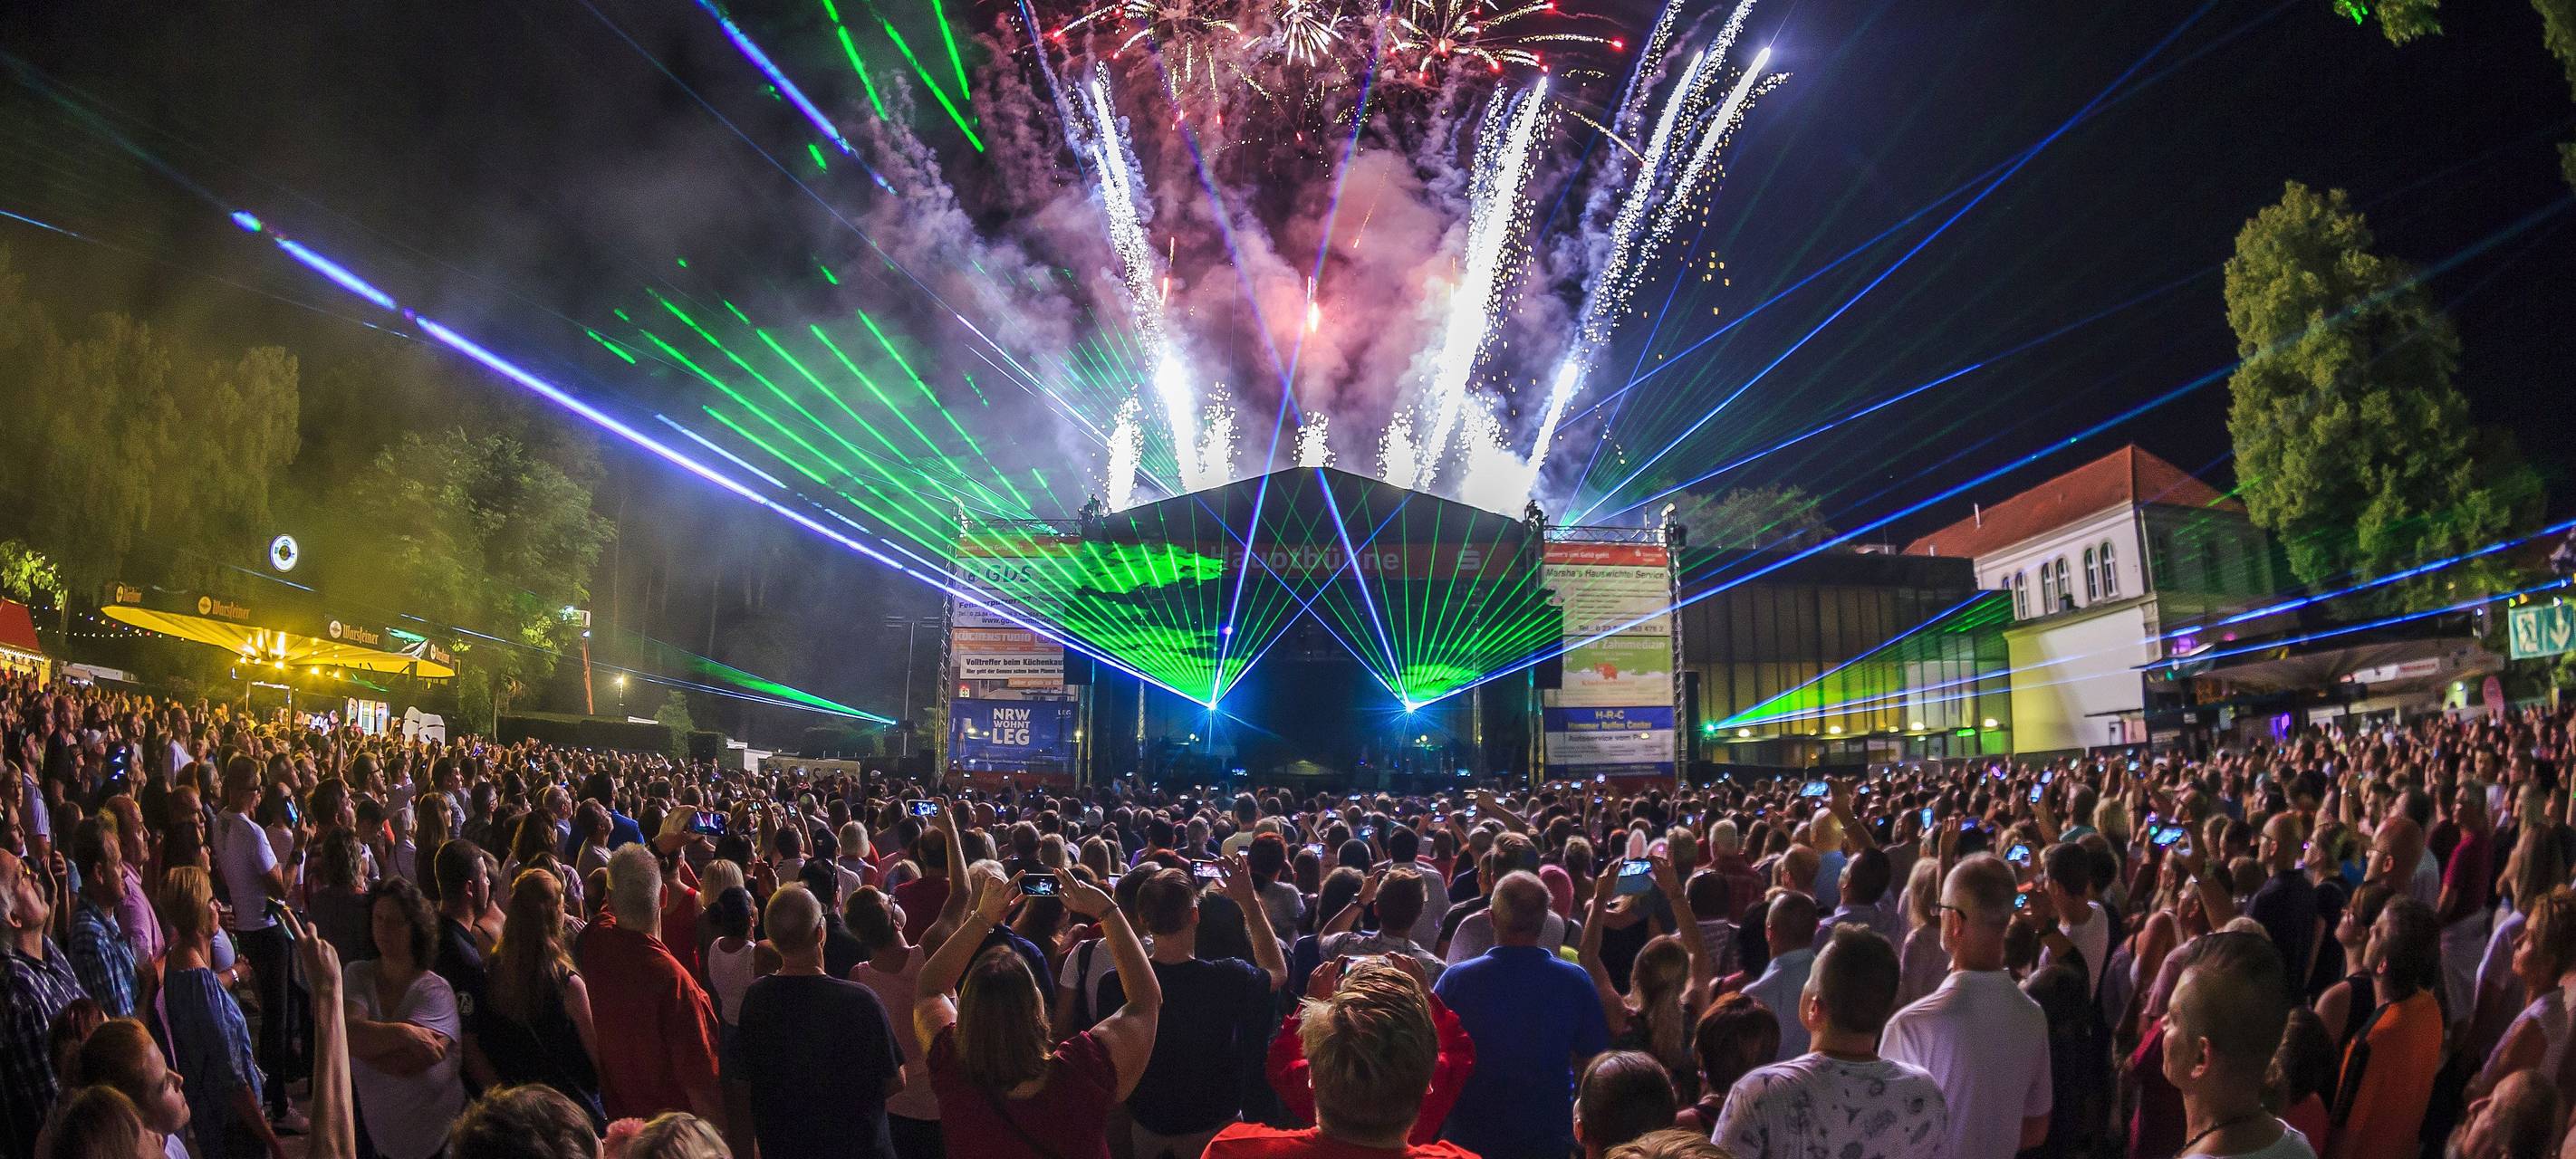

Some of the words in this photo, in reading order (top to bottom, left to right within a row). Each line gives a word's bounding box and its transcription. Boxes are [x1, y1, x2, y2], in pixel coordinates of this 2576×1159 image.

[985, 565, 1033, 582] GDS
[1636, 570, 1664, 579] Service
[342, 624, 379, 645] Warsteiner
[993, 708, 1031, 721] NRW
[1595, 710, 1625, 719] H-R-C
[992, 728, 1030, 745] LEG
